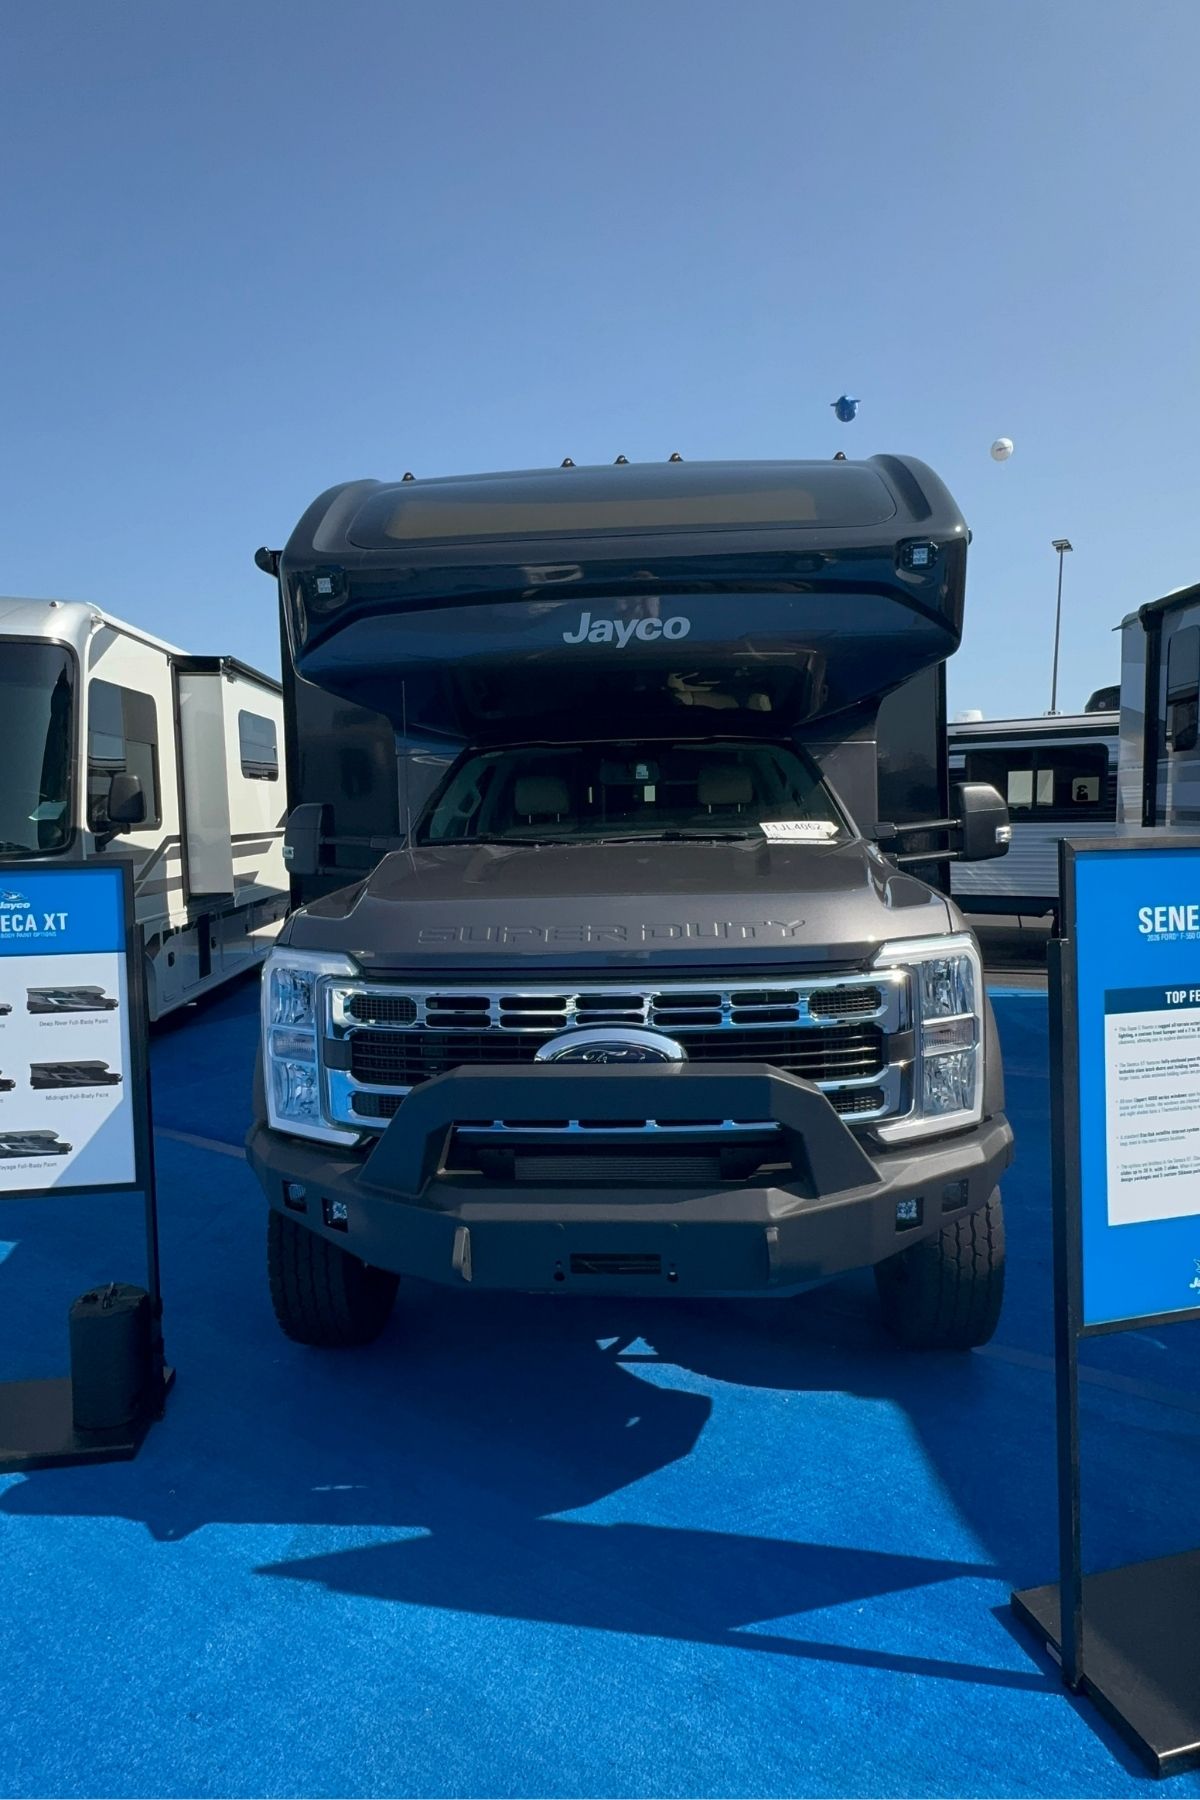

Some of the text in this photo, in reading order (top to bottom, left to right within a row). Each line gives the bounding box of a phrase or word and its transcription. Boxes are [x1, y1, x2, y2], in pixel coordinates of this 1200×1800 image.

[563, 612, 691, 648] Jayco
[0, 912, 69, 932] ECA XT
[418, 918, 806, 944] SUPER DUTY
[1138, 905, 1200, 933] SENE
[1165, 988, 1200, 1004] TOP FE
